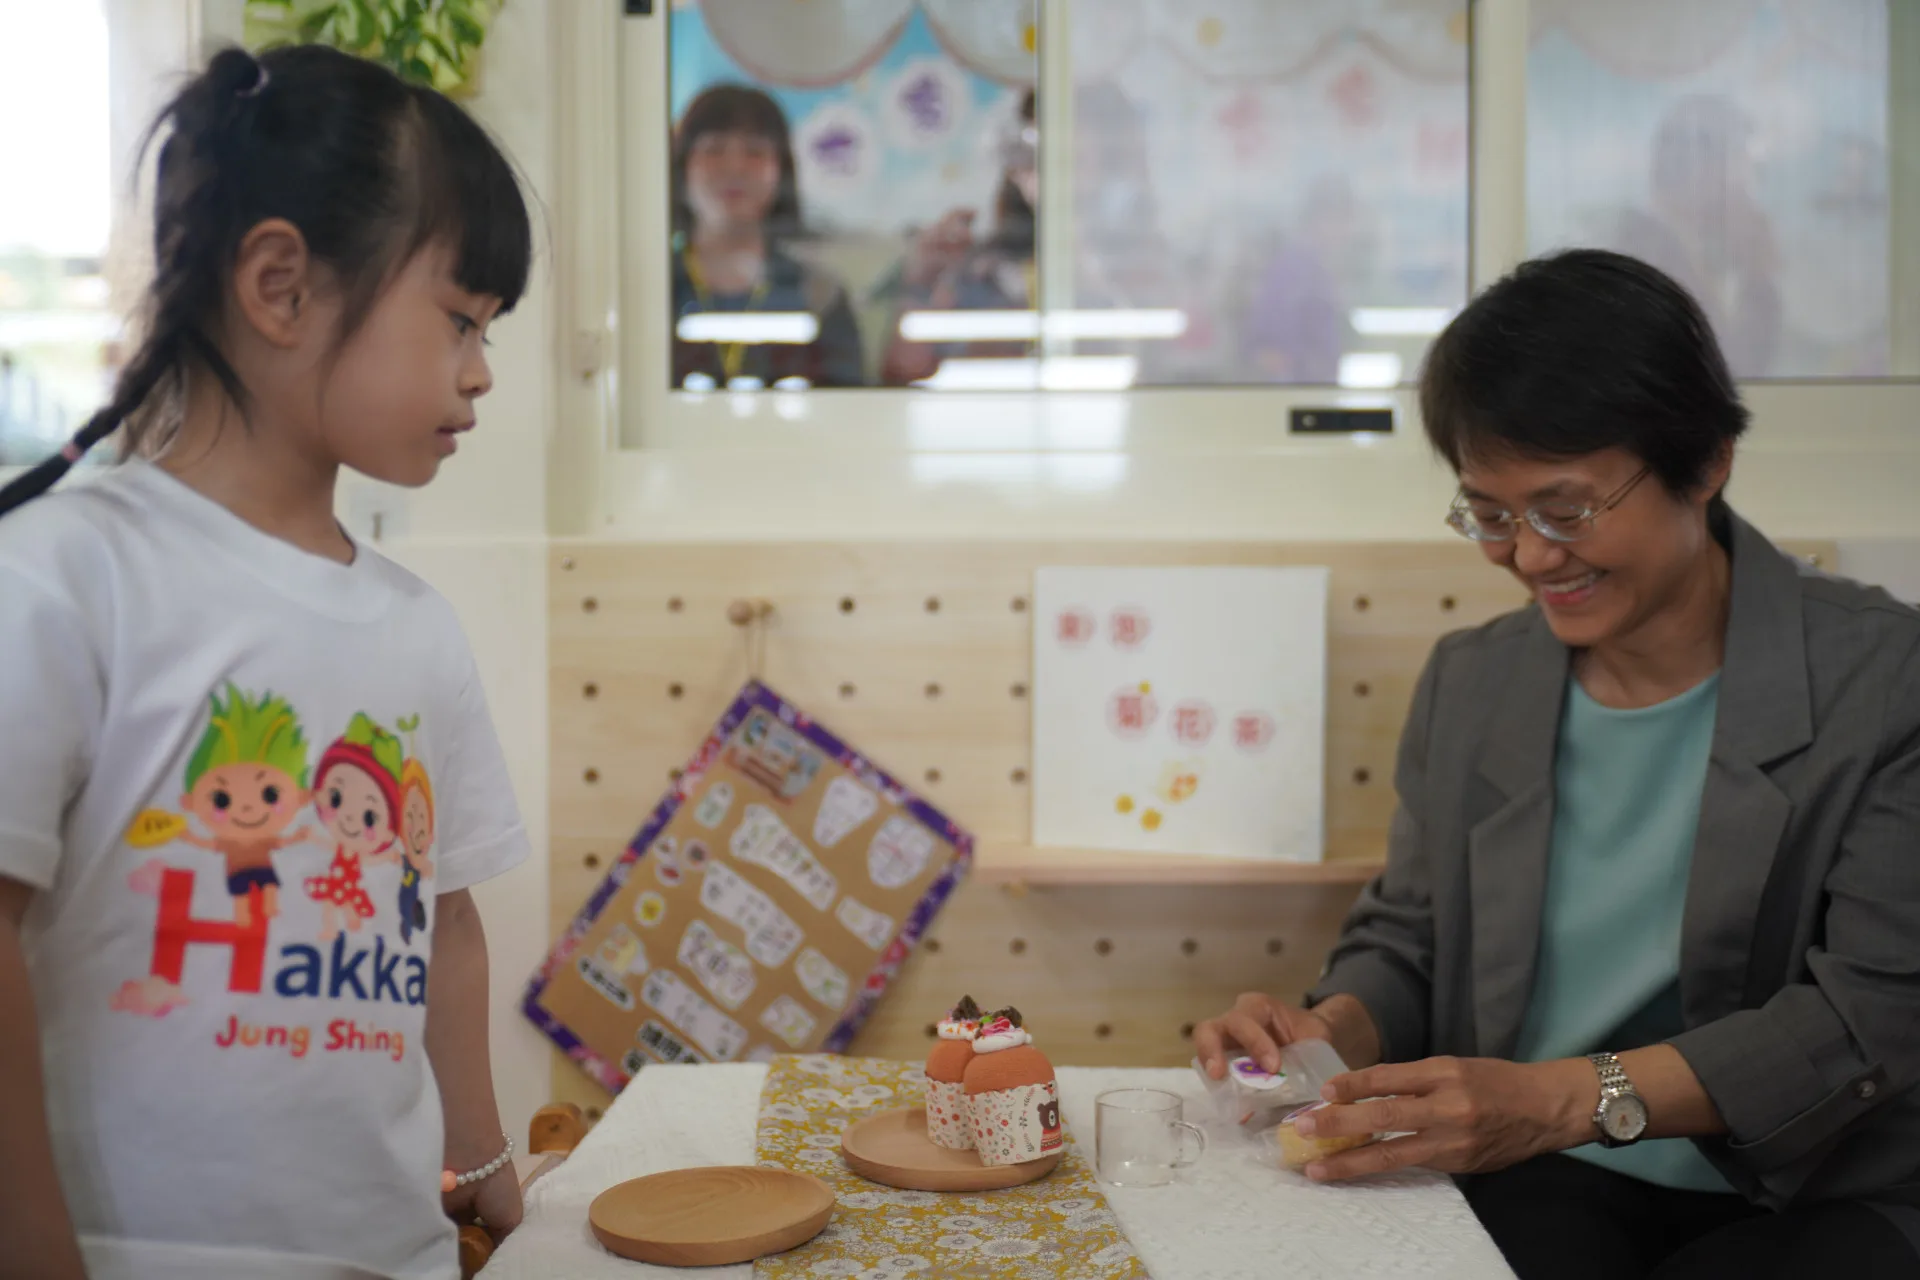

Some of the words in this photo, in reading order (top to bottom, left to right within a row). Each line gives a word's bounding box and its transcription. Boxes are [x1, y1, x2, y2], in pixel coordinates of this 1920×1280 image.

[150, 868, 427, 1006] Hakka
[215, 1015, 311, 1058] Jung
[324, 1019, 405, 1061] Shing
